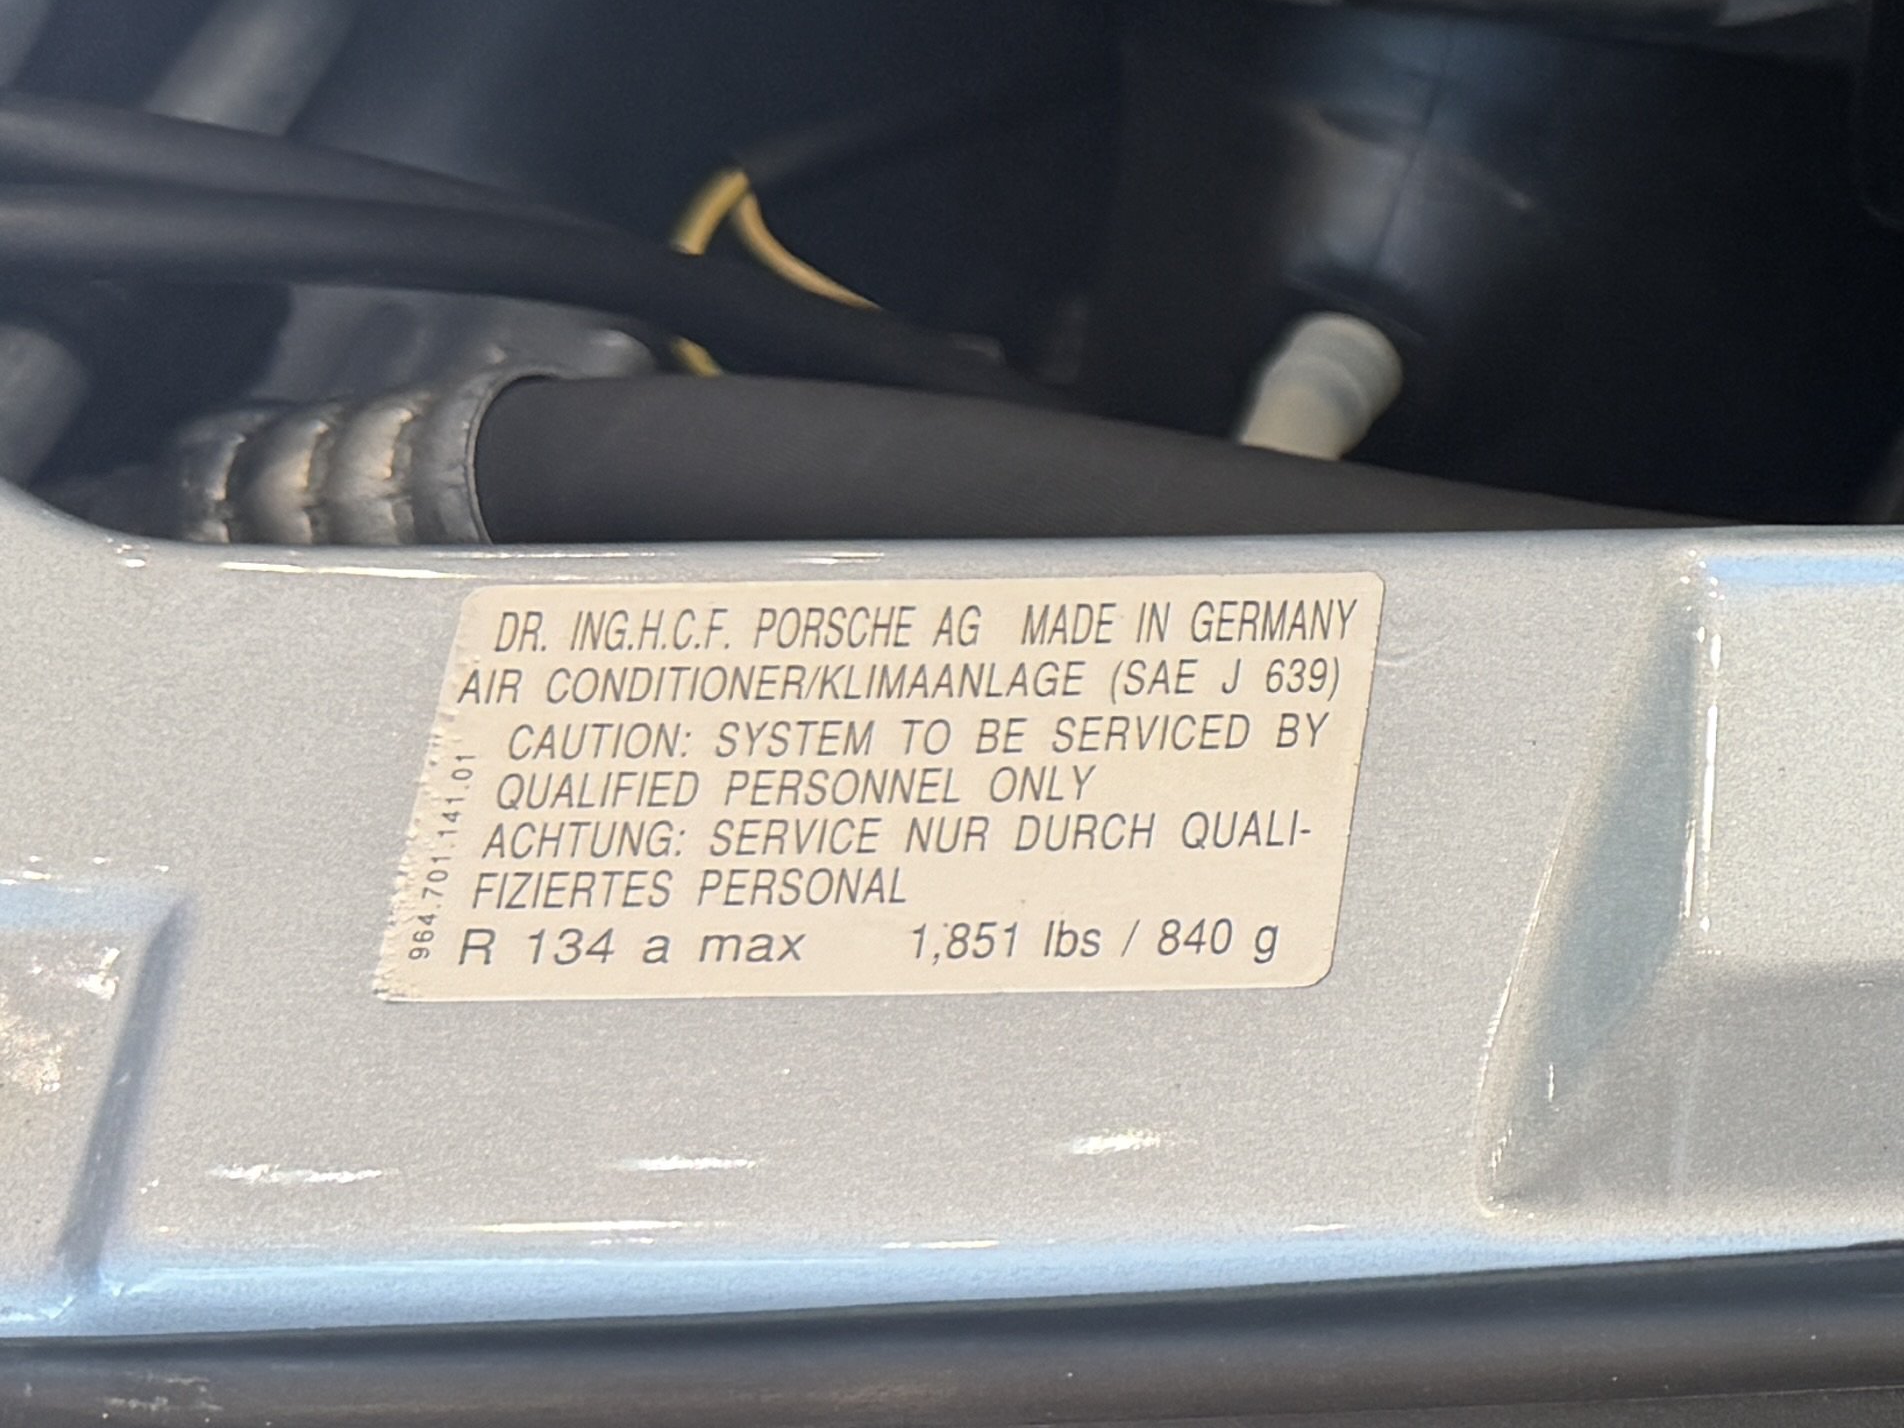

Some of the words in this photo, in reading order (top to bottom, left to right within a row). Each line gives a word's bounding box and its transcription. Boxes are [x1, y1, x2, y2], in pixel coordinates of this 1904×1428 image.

[492, 609, 547, 653] DR.
[569, 606, 730, 652] ING.H.C.F.
[752, 604, 916, 649] PORSCHE
[931, 603, 982, 647] AG
[1020, 601, 1117, 645] MADE
[1135, 600, 1171, 643] IN
[1189, 597, 1358, 643] GERMANY
[455, 667, 523, 704] AIR
[545, 659, 1086, 704] CONDITIONER/KLIMAANLAGE
[1109, 657, 1199, 705] (SAE
[1220, 657, 1242, 695] J
[1264, 656, 1340, 702] 639)
[507, 721, 691, 761] CAUTION:
[714, 719, 875, 758] SYSTEM
[900, 717, 951, 756] TO
[974, 716, 1028, 755] BE
[1051, 712, 1251, 754] SERVICED
[1274, 710, 1330, 748] BY
[495, 769, 700, 811] QUALIFIED
[723, 766, 960, 807] PERSONNEL
[988, 763, 1096, 803] ONLY
[407, 754, 477, 961] 964.701.141.01
[480, 818, 685, 860] ACHTUNG:
[708, 816, 882, 857] SERVICE
[904, 814, 990, 854] NUR
[1013, 811, 1156, 852] DURCH
[1180, 808, 1311, 850] QUALI-
[471, 868, 673, 910] FIZIERTES
[696, 866, 906, 906] PERSONAL
[457, 927, 496, 966] R
[527, 927, 615, 966] 134
[641, 933, 670, 964] a
[698, 932, 805, 963] max
[911, 920, 1018, 965] 1,851
[1042, 918, 1101, 958] lbs
[1120, 918, 1140, 956] /
[1156, 916, 1233, 956] 840
[1252, 924, 1279, 965] g
